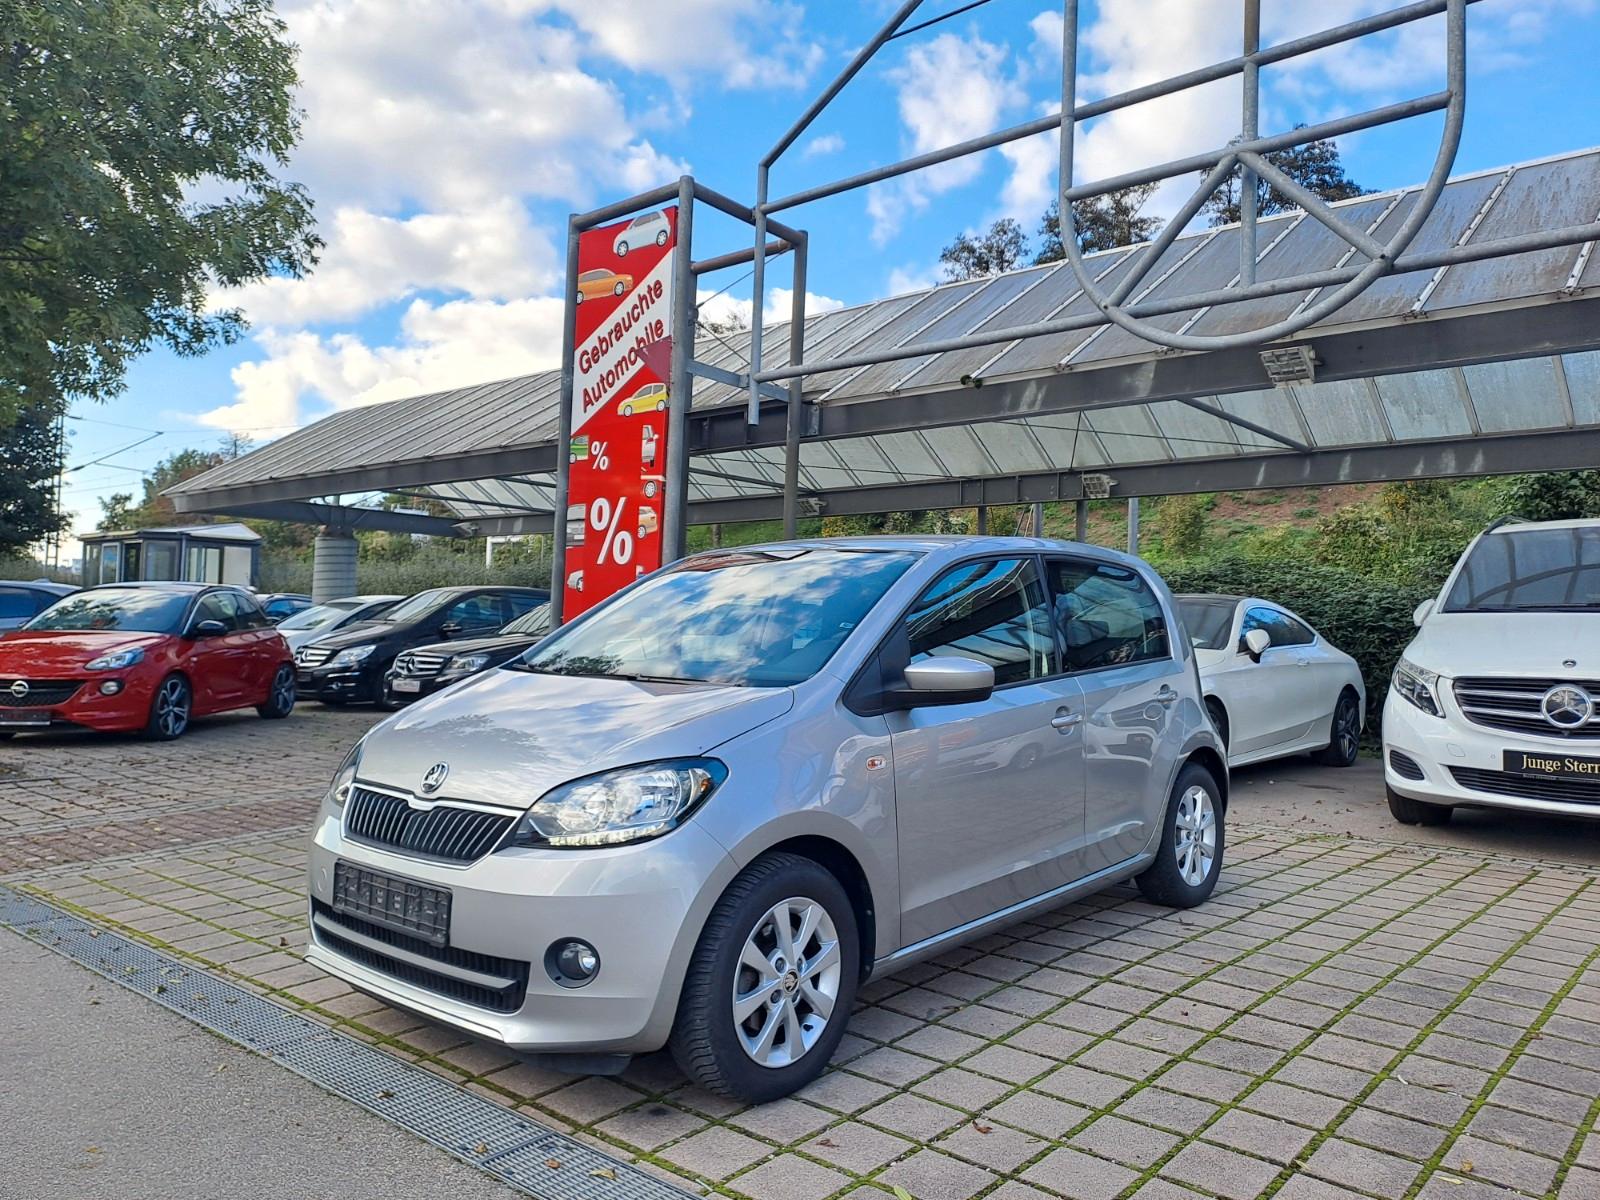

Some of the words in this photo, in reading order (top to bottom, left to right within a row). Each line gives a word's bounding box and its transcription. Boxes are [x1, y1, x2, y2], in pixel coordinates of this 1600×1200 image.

[579, 280, 663, 374] Gebrauchte
[591, 441, 609, 470] %
[590, 497, 633, 565] %
[1522, 754, 1561, 772] Junge
